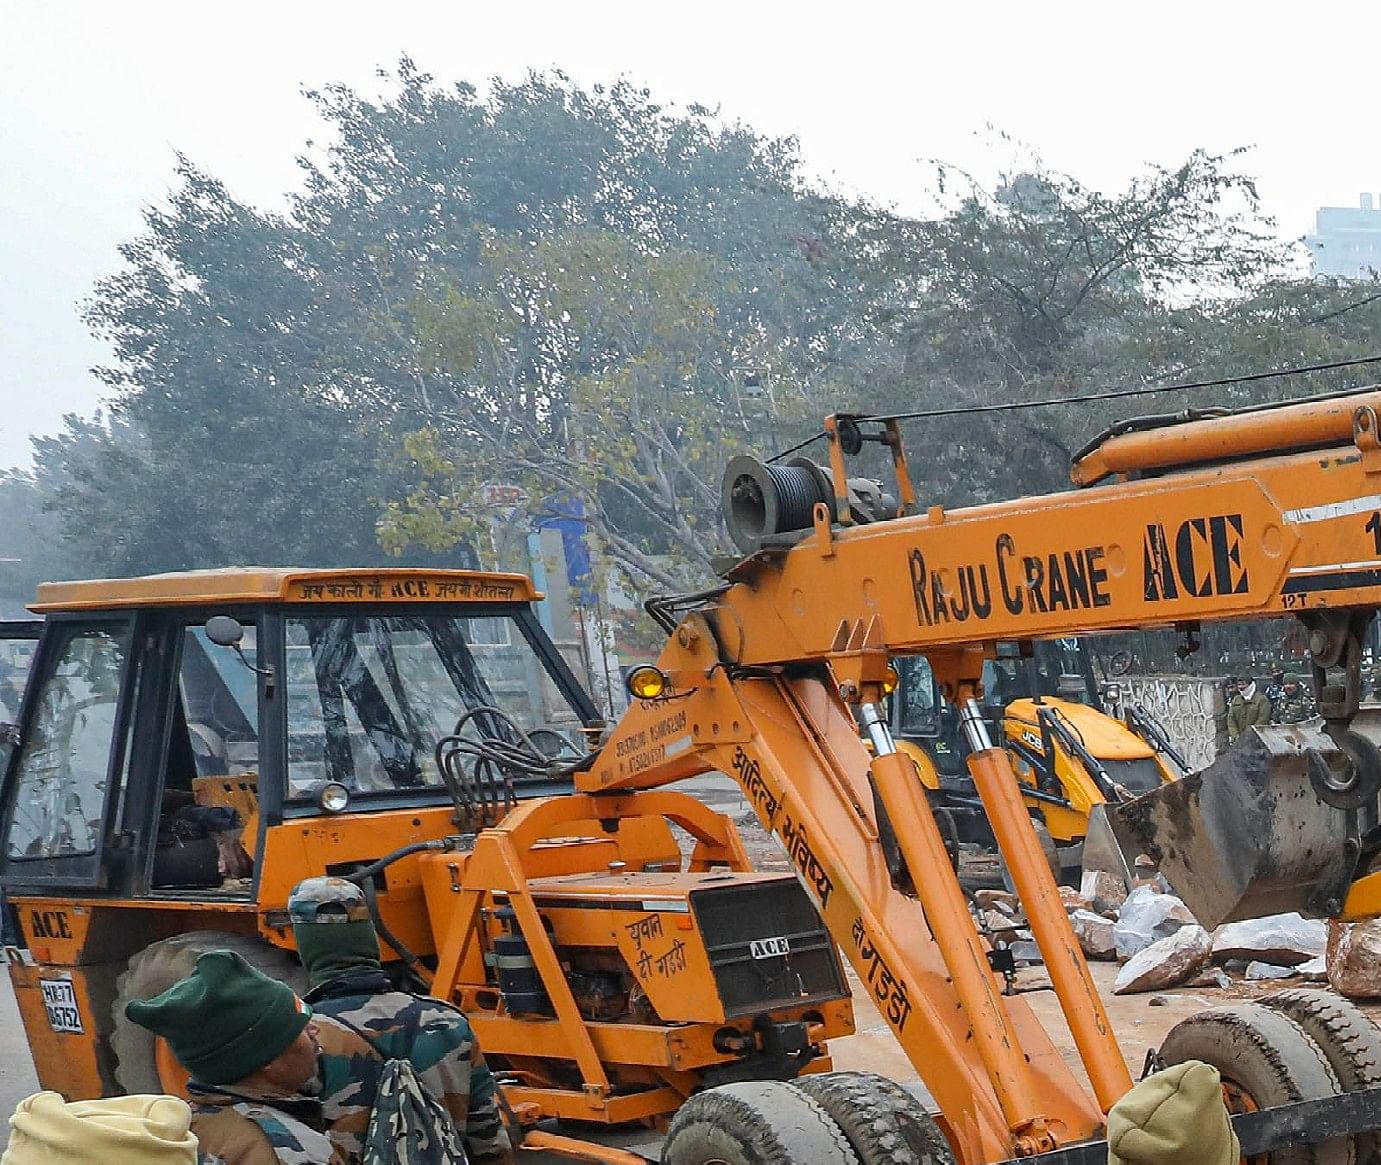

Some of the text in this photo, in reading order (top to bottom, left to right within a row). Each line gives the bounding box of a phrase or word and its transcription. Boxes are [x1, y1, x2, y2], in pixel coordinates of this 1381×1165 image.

[1143, 513, 1249, 602] ACE
[391, 580, 431, 598] ACE
[1022, 731, 1042, 748] JCB
[32, 911, 73, 939] ACE
[752, 937, 789, 958] ACE
